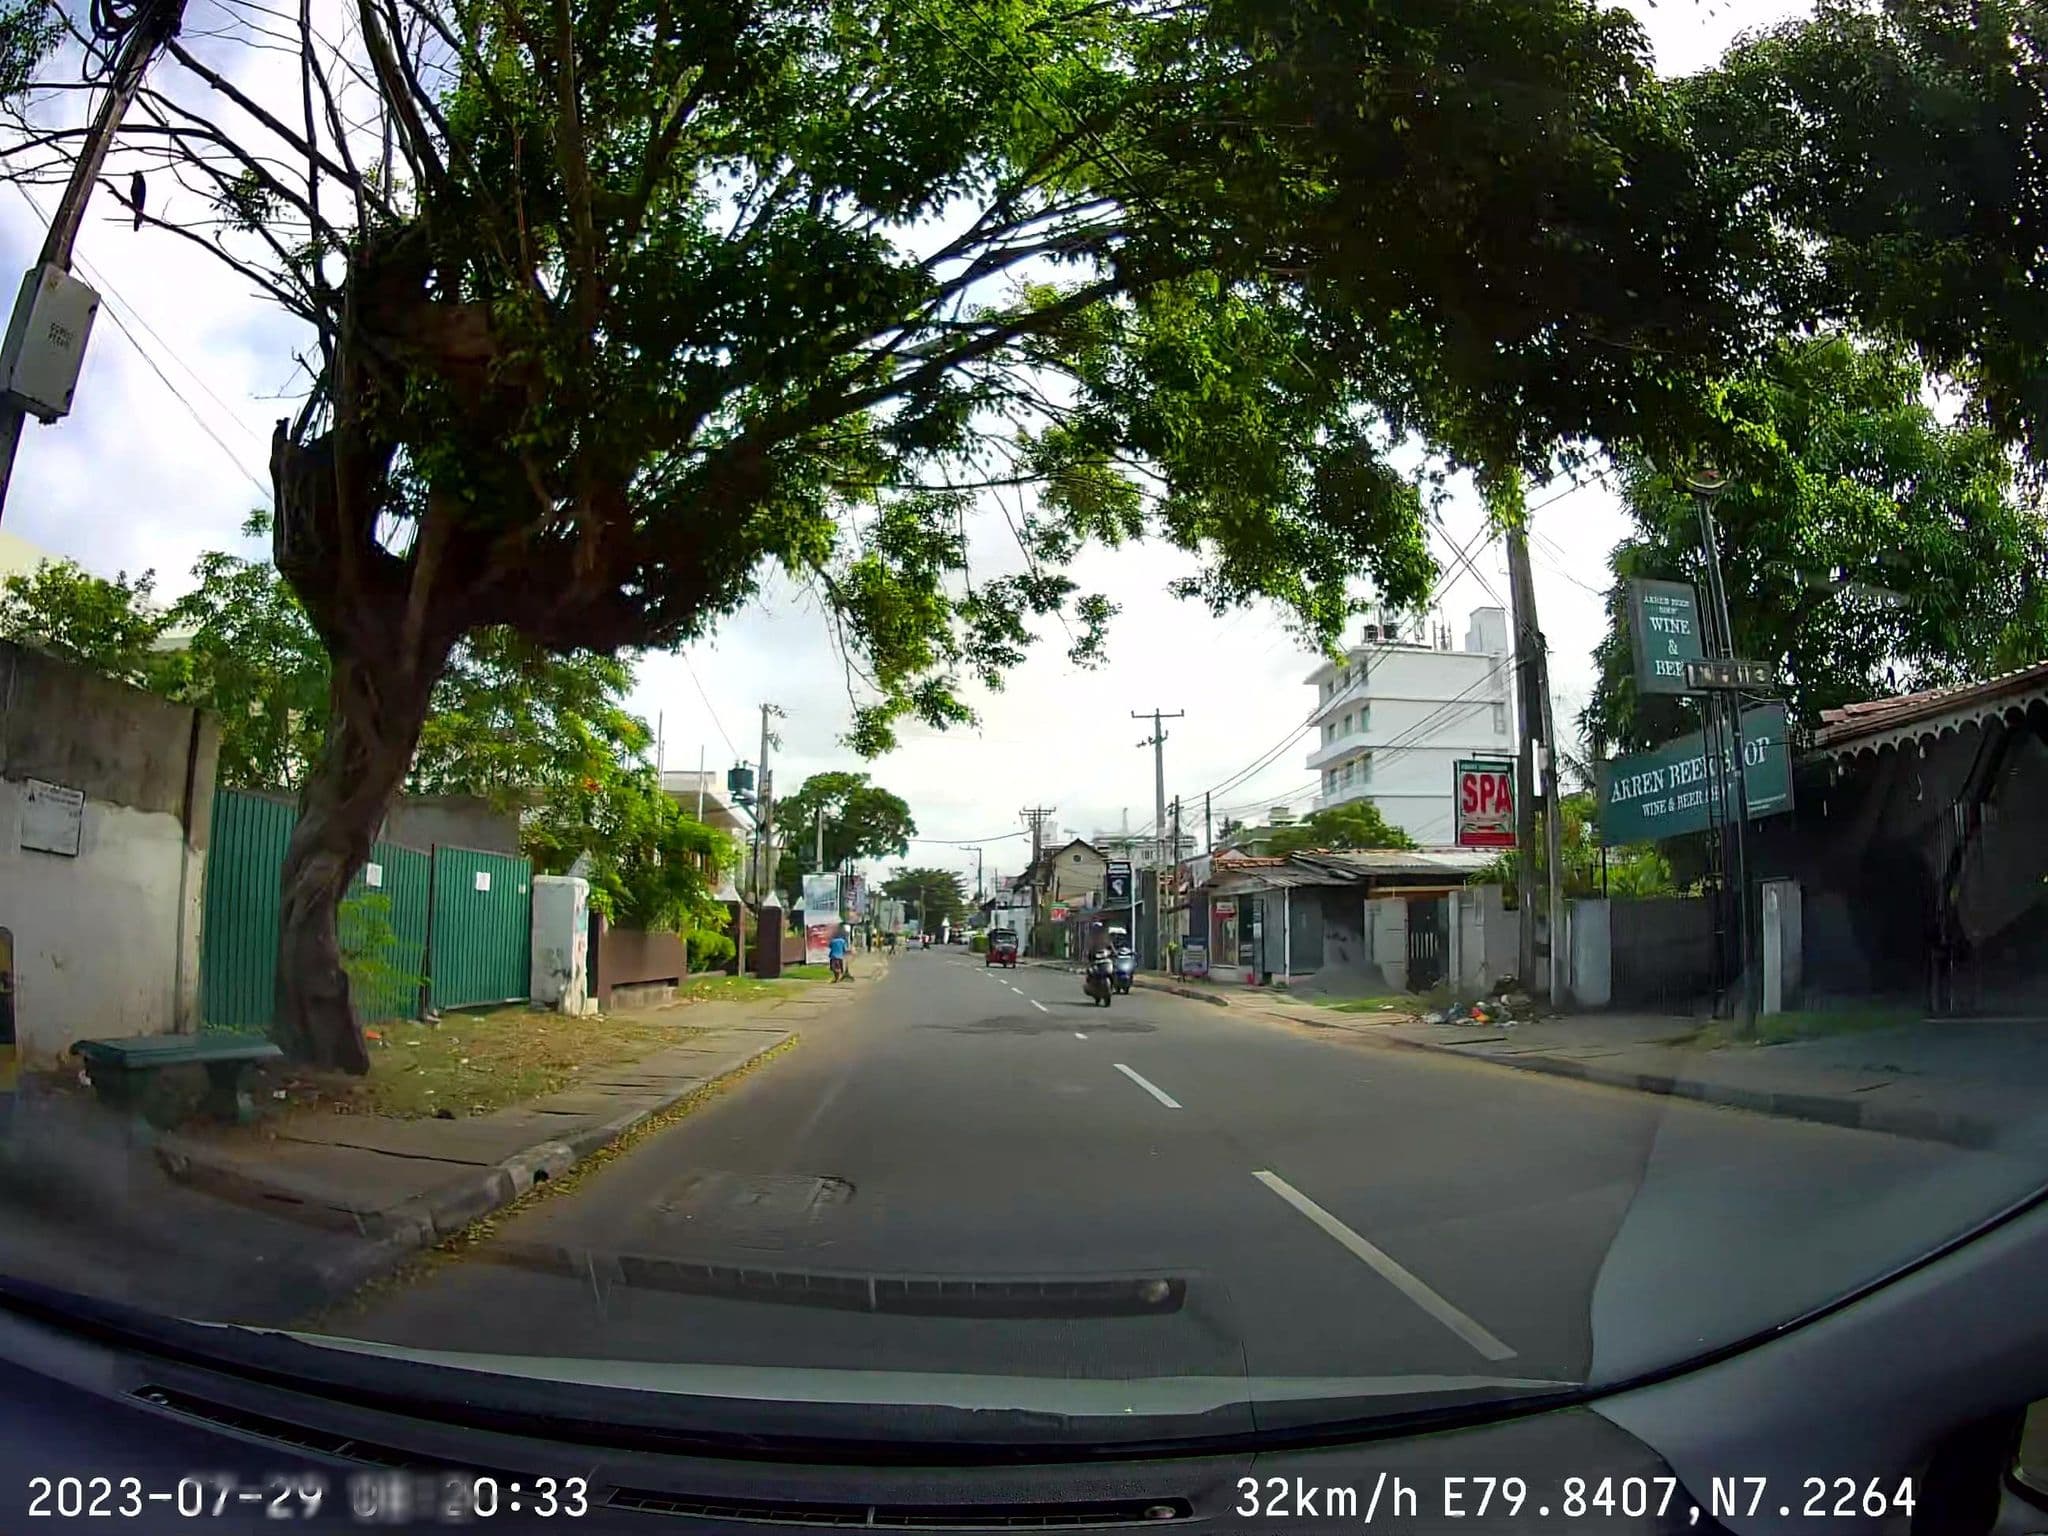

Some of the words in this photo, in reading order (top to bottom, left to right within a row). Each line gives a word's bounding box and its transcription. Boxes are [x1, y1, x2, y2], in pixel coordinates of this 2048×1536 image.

[1649, 616, 1691, 635] WINE
[1667, 639, 1679, 655] &
[1655, 660, 1685, 678] BEE
[1611, 768, 1665, 803] ARREN
[1724, 736, 1770, 773] SOP
[1462, 773, 1512, 814] SPA
[1641, 800, 1667, 817] WINE
[1667, 797, 1675, 812] &
[1677, 790, 1703, 810] BEER
